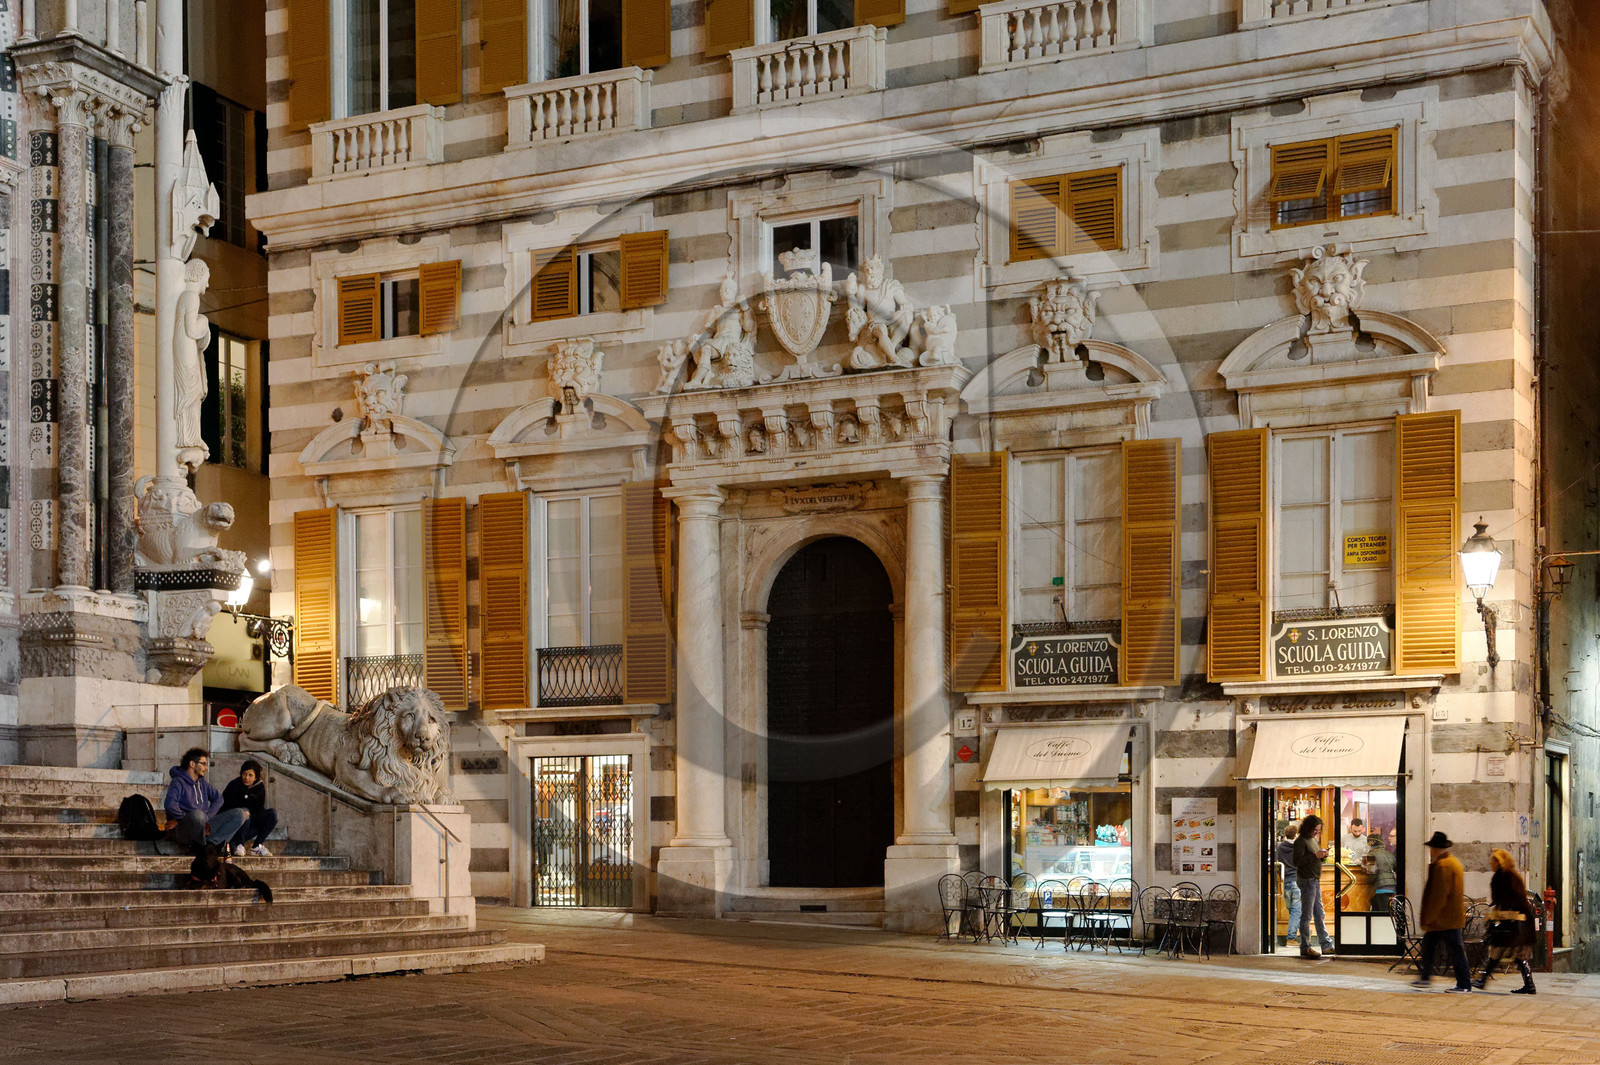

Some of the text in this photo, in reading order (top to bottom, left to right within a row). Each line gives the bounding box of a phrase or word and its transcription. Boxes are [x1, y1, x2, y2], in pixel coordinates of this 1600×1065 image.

[1359, 541, 1387, 549] STRANIERI
[1306, 625, 1379, 641] S. LORENZO
[1043, 640, 1109, 654] S. LORENZO
[1278, 640, 1387, 664] SCUOLA GUIDA
[1017, 655, 1114, 675] SCUOLA GUIDA
[1285, 661, 1381, 675] TEL. 010-2471977
[1023, 677, 1046, 686] TEL.
[1311, 695, 1337, 711] del
[1342, 694, 1398, 710] Duomo
[1074, 704, 1124, 718] Duomo
[961, 719, 972, 728] 17
[1033, 750, 1049, 758] del
[1299, 745, 1354, 754] del Duomo
